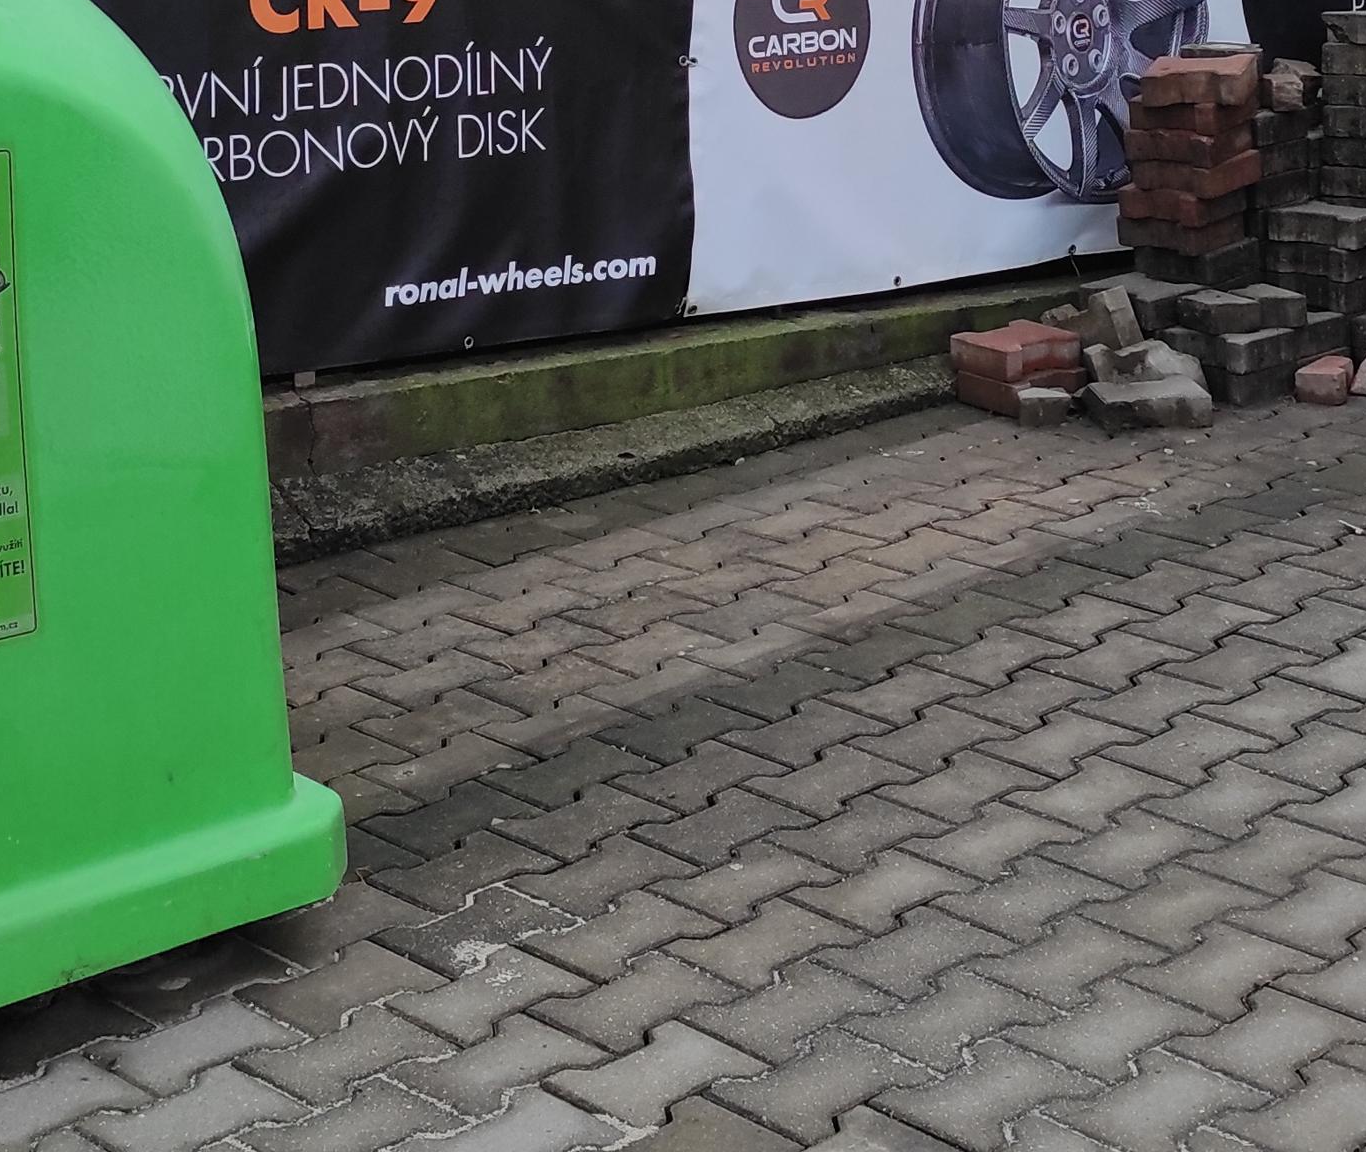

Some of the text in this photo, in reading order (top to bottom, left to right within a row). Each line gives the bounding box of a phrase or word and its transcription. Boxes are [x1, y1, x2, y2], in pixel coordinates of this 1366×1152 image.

[748, 26, 857, 59] CARBON
[751, 52, 857, 74] REVOLUTION
[271, 35, 554, 122] JEDNODÍLNÝ
[202, 104, 547, 184] RBONOVÝ DISK
[384, 254, 657, 308] ronal-wheels.com
